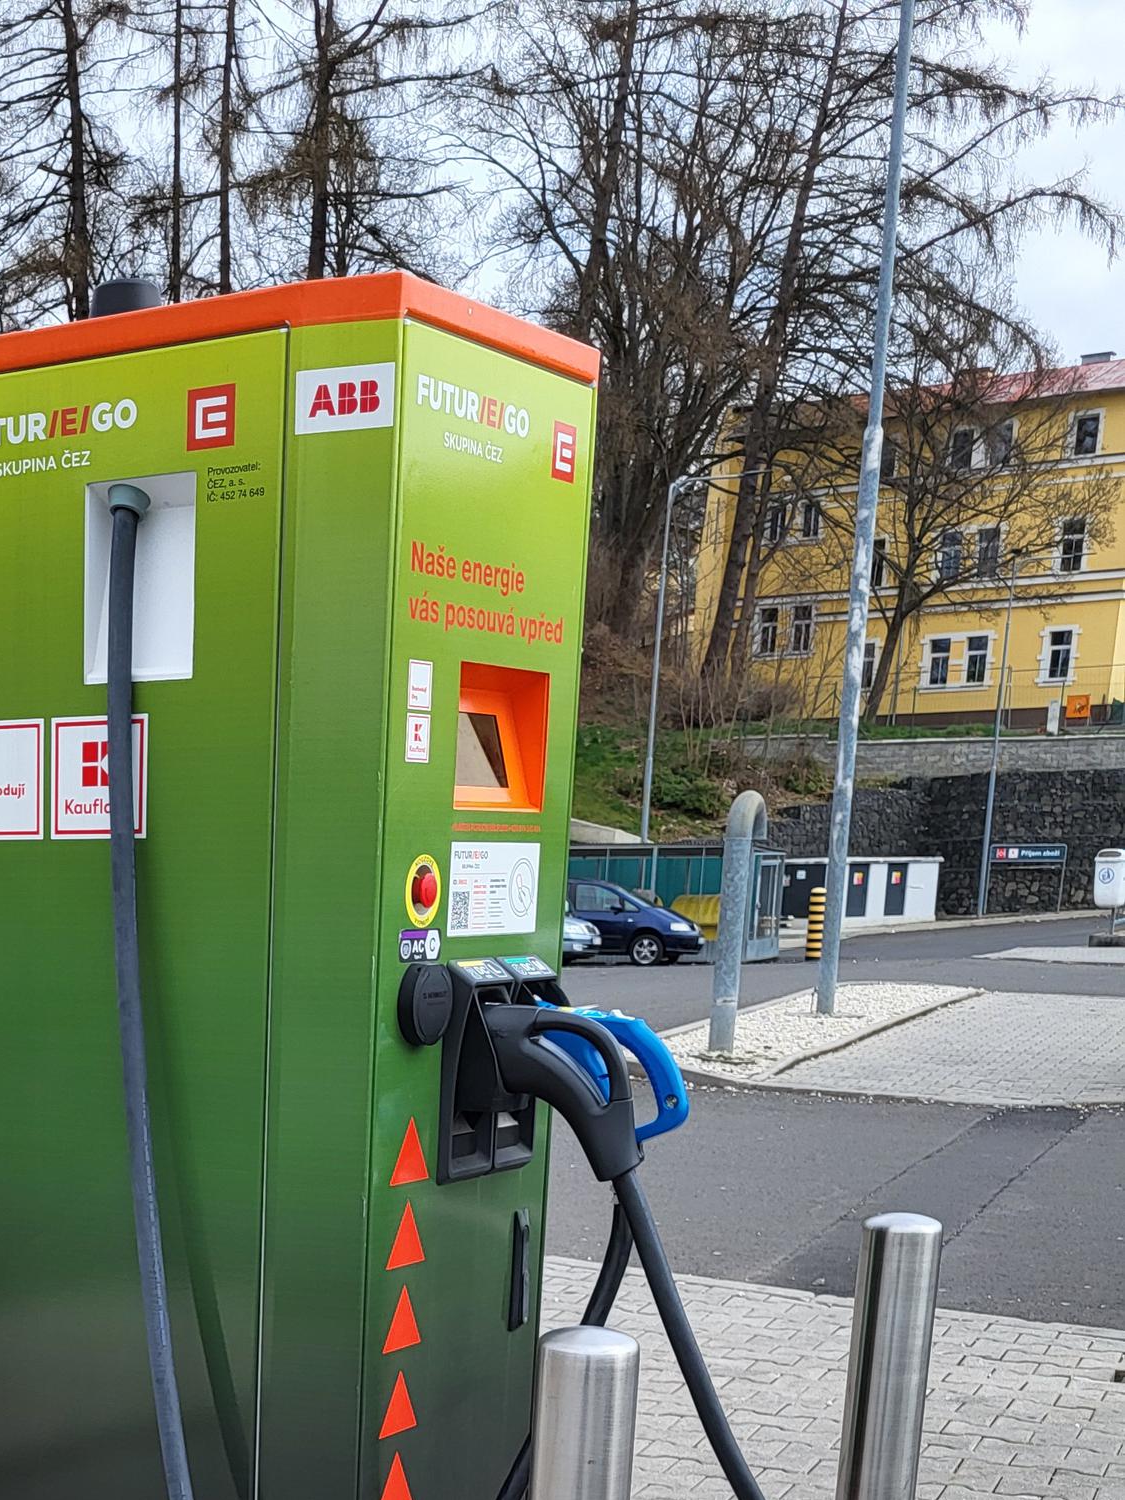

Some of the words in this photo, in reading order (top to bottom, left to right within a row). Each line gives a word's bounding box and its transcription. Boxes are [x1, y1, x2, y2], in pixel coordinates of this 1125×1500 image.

[308, 380, 380, 418] ABB
[417, 373, 530, 438] FUTUR/E/GO
[61, 449, 91, 468] ČEZ
[443, 431, 483, 458] SKUPINA
[485, 440, 503, 464] ČEZ
[207, 461, 261, 476] Provozovatel:
[220, 490, 236, 501] 452
[237, 489, 248, 499] 74
[249, 487, 265, 498] 649
[410, 541, 457, 579] Naše
[461, 560, 525, 596] energie
[409, 591, 439, 623] vás
[444, 602, 515, 635] posouvá
[519, 612, 564, 644] vpřed
[64, 799, 111, 816] Kaufla
[412, 940, 425, 953] AC
